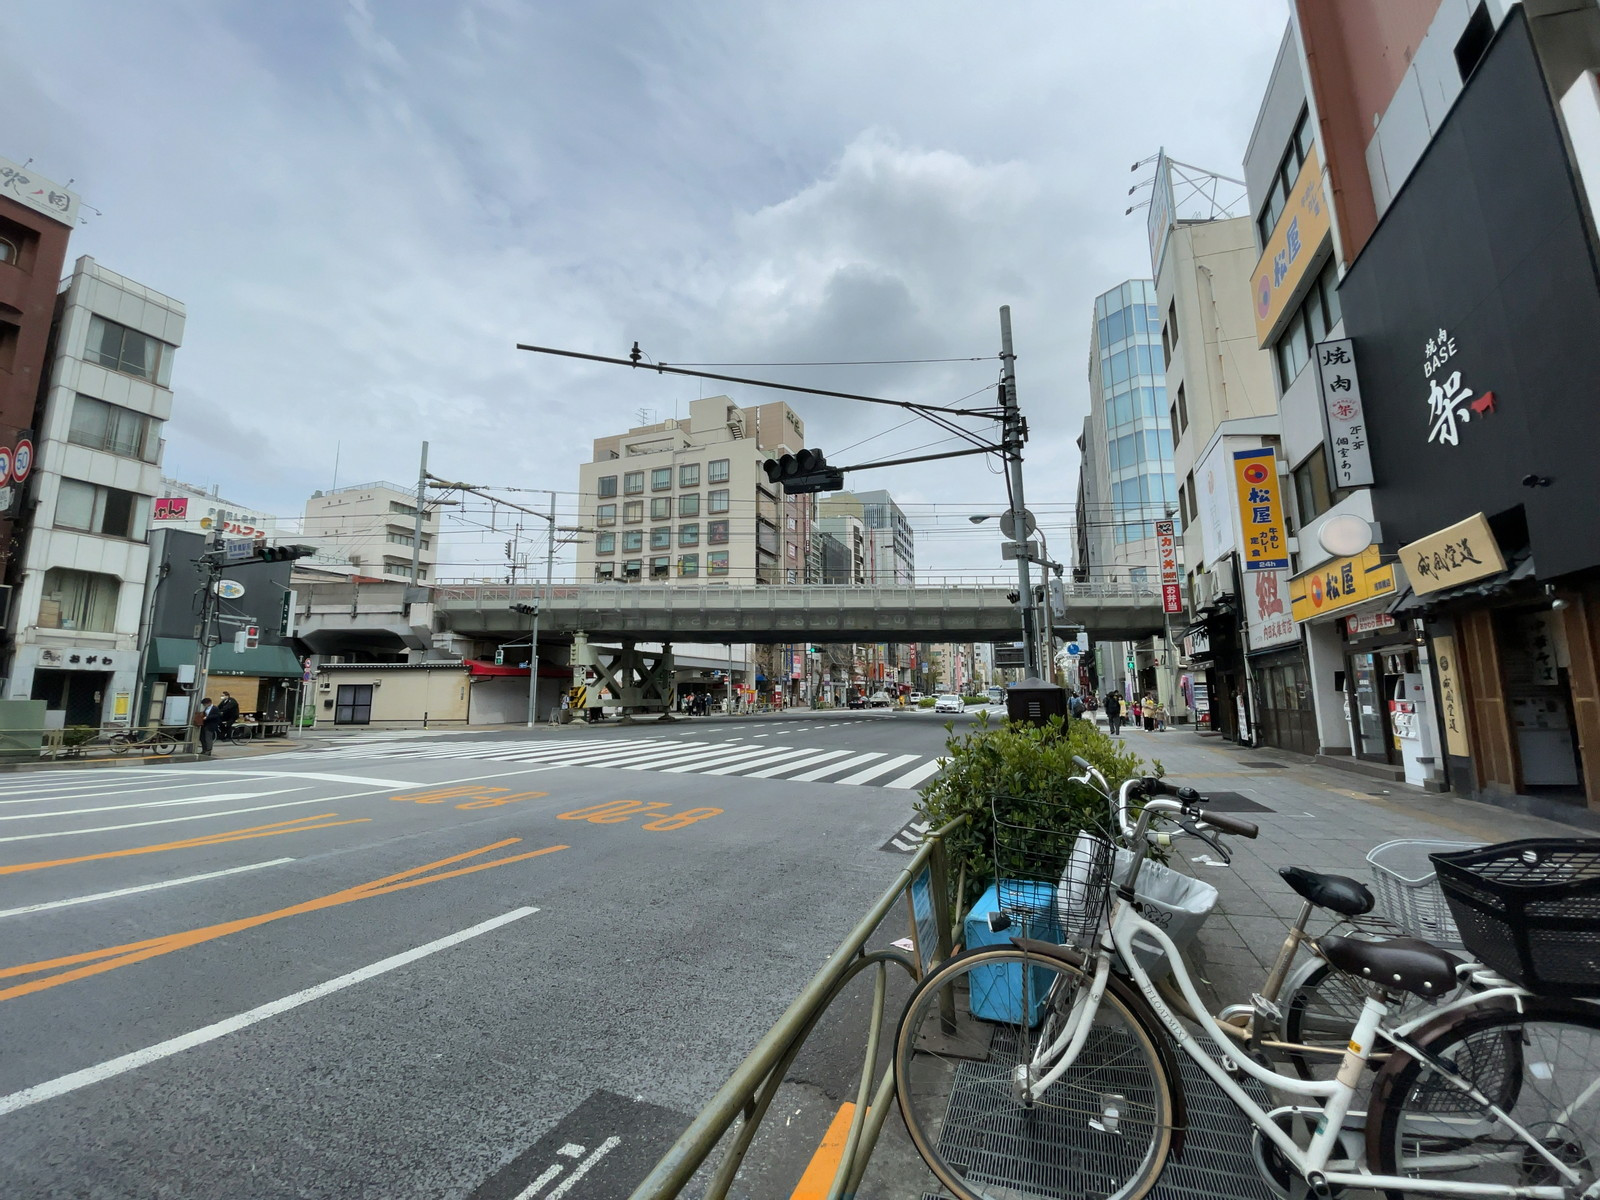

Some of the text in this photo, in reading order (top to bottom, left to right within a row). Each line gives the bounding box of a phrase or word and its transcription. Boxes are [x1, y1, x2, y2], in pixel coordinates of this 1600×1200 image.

[1273, 215, 1302, 288] 松屋
[1424, 337, 1457, 378] BASE
[1425, 328, 1447, 358] 焼肉
[1323, 347, 1351, 392] 焼肉
[1428, 371, 1473, 446] 架
[16, 451, 28, 470] 50
[1335, 437, 1352, 481] 個室あり
[1248, 487, 1272, 524] 松屋
[1161, 537, 1175, 569] カツ丼
[1250, 537, 1261, 557] 定食
[1260, 531, 1269, 553] カレー
[1269, 527, 1279, 549] 牛めし
[1326, 562, 1356, 601] 松屋
[1166, 586, 1178, 611] お弁当
[69, 654, 113, 665] おがわ
[556, 800, 724, 831] 8-20
